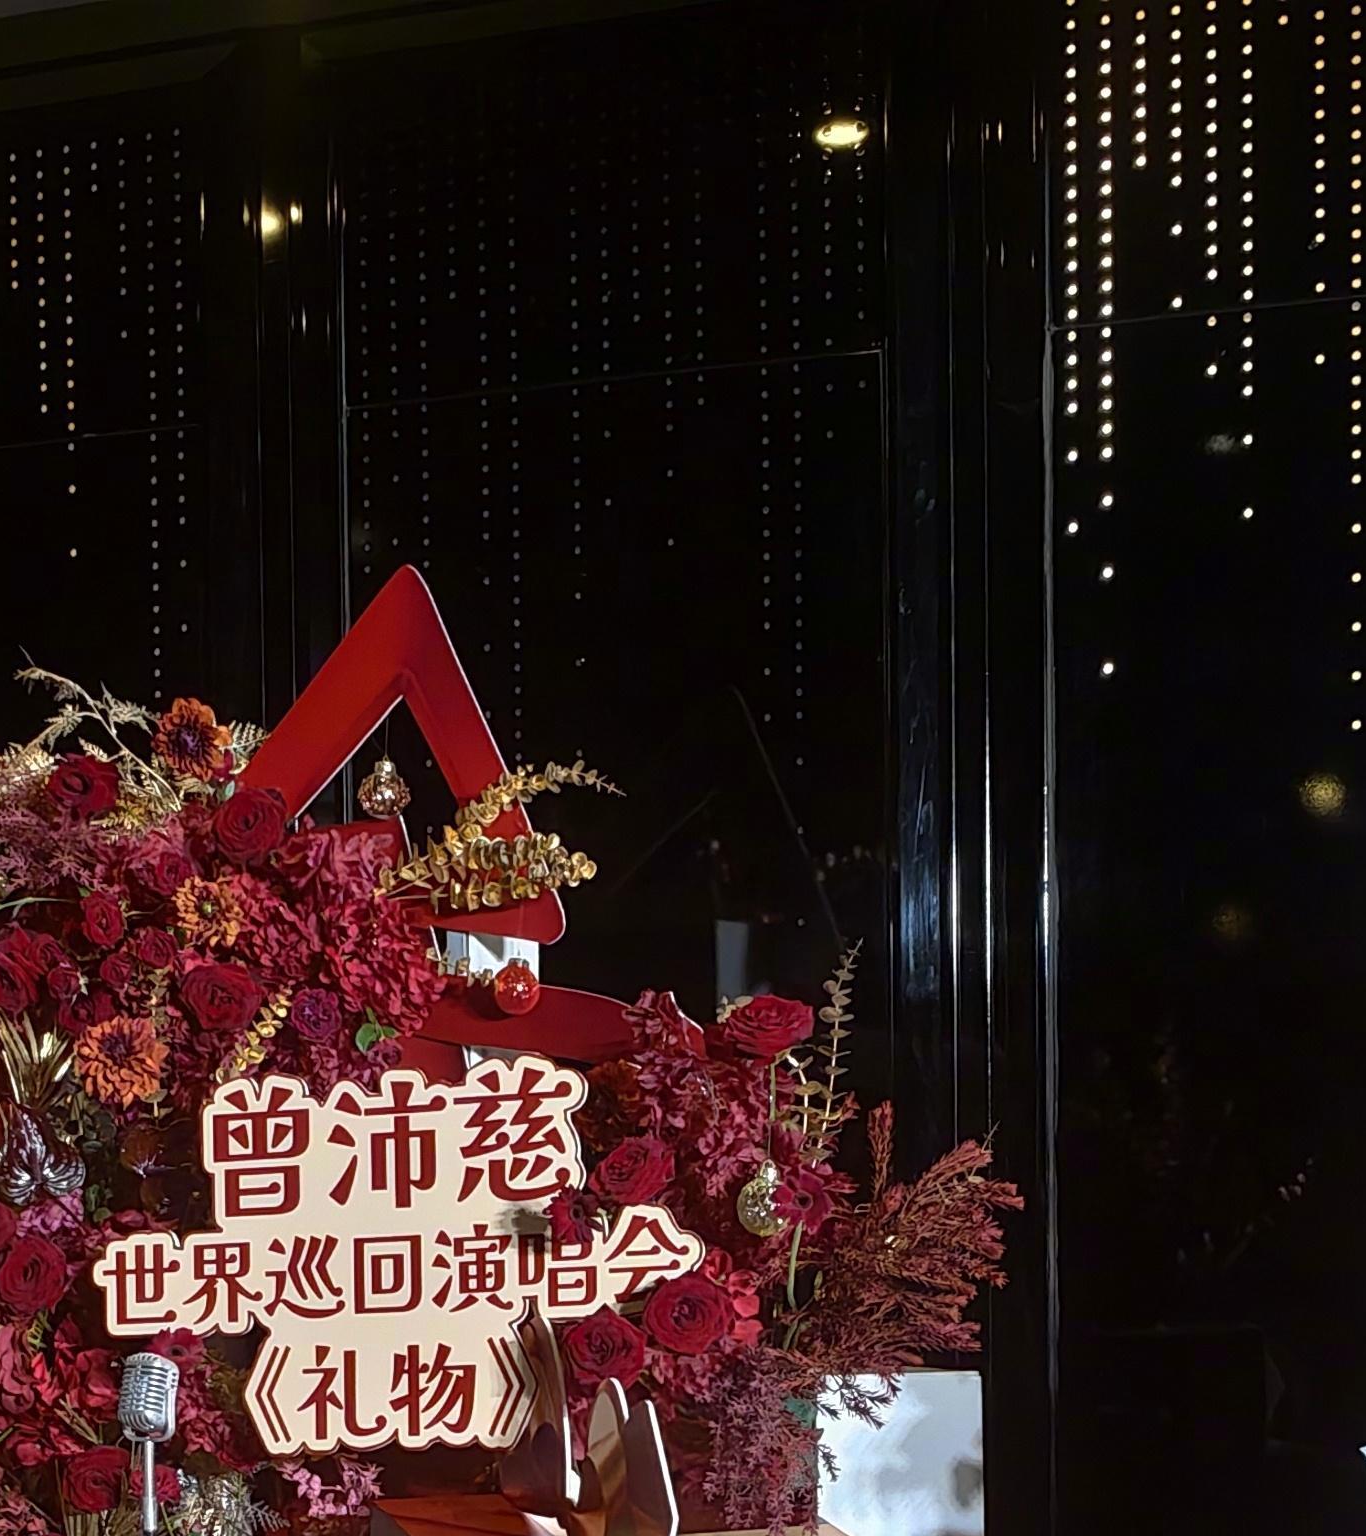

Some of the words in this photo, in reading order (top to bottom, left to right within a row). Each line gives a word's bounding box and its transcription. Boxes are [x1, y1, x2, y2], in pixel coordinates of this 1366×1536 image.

[212, 1067, 572, 1218] 曾沛慈
[102, 1215, 683, 1326] 世界巡回演唱会
[255, 1337, 529, 1445] 《礼物》
